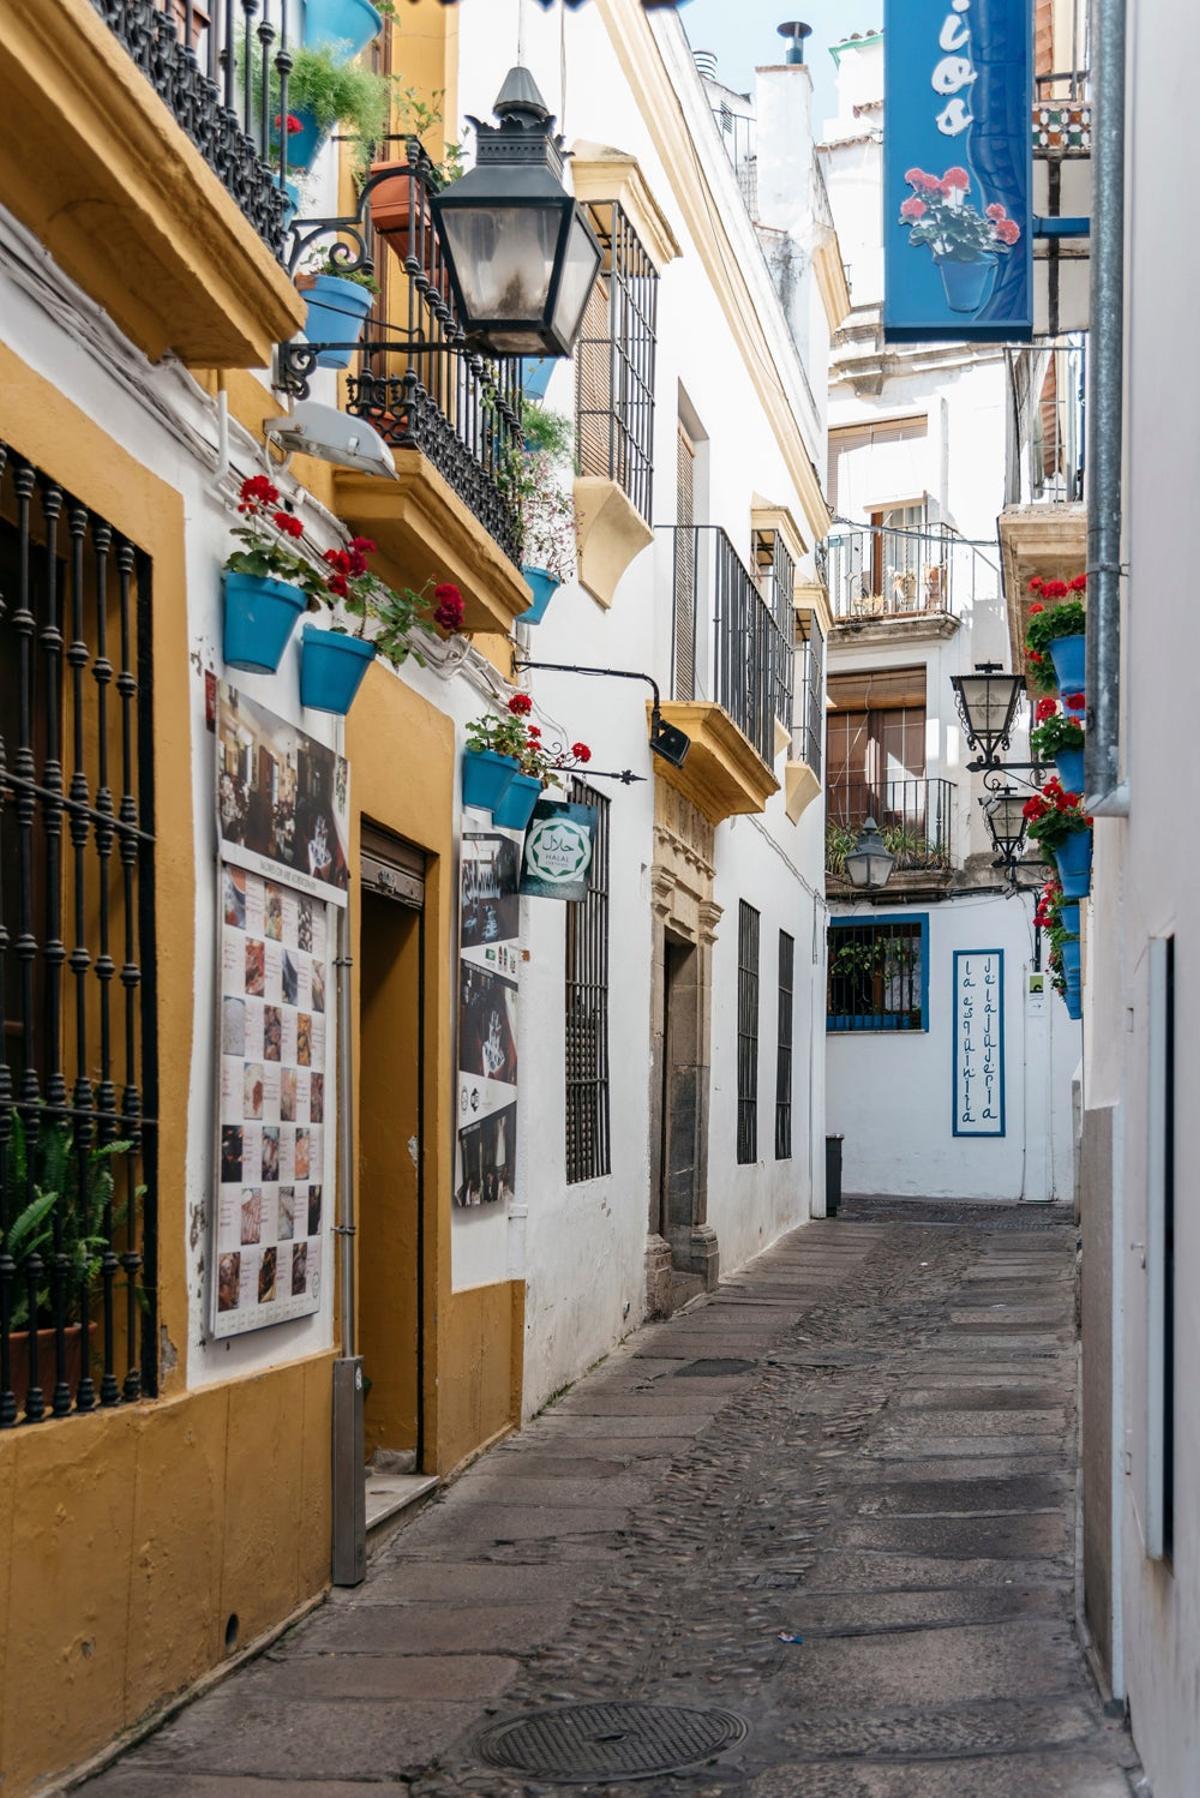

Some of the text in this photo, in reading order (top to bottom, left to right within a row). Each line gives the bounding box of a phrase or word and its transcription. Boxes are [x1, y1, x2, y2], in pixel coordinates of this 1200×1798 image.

[542, 834, 575, 851] حلال
[545, 854, 569, 862] HALAL
[962, 960, 977, 1122] la esquinita
